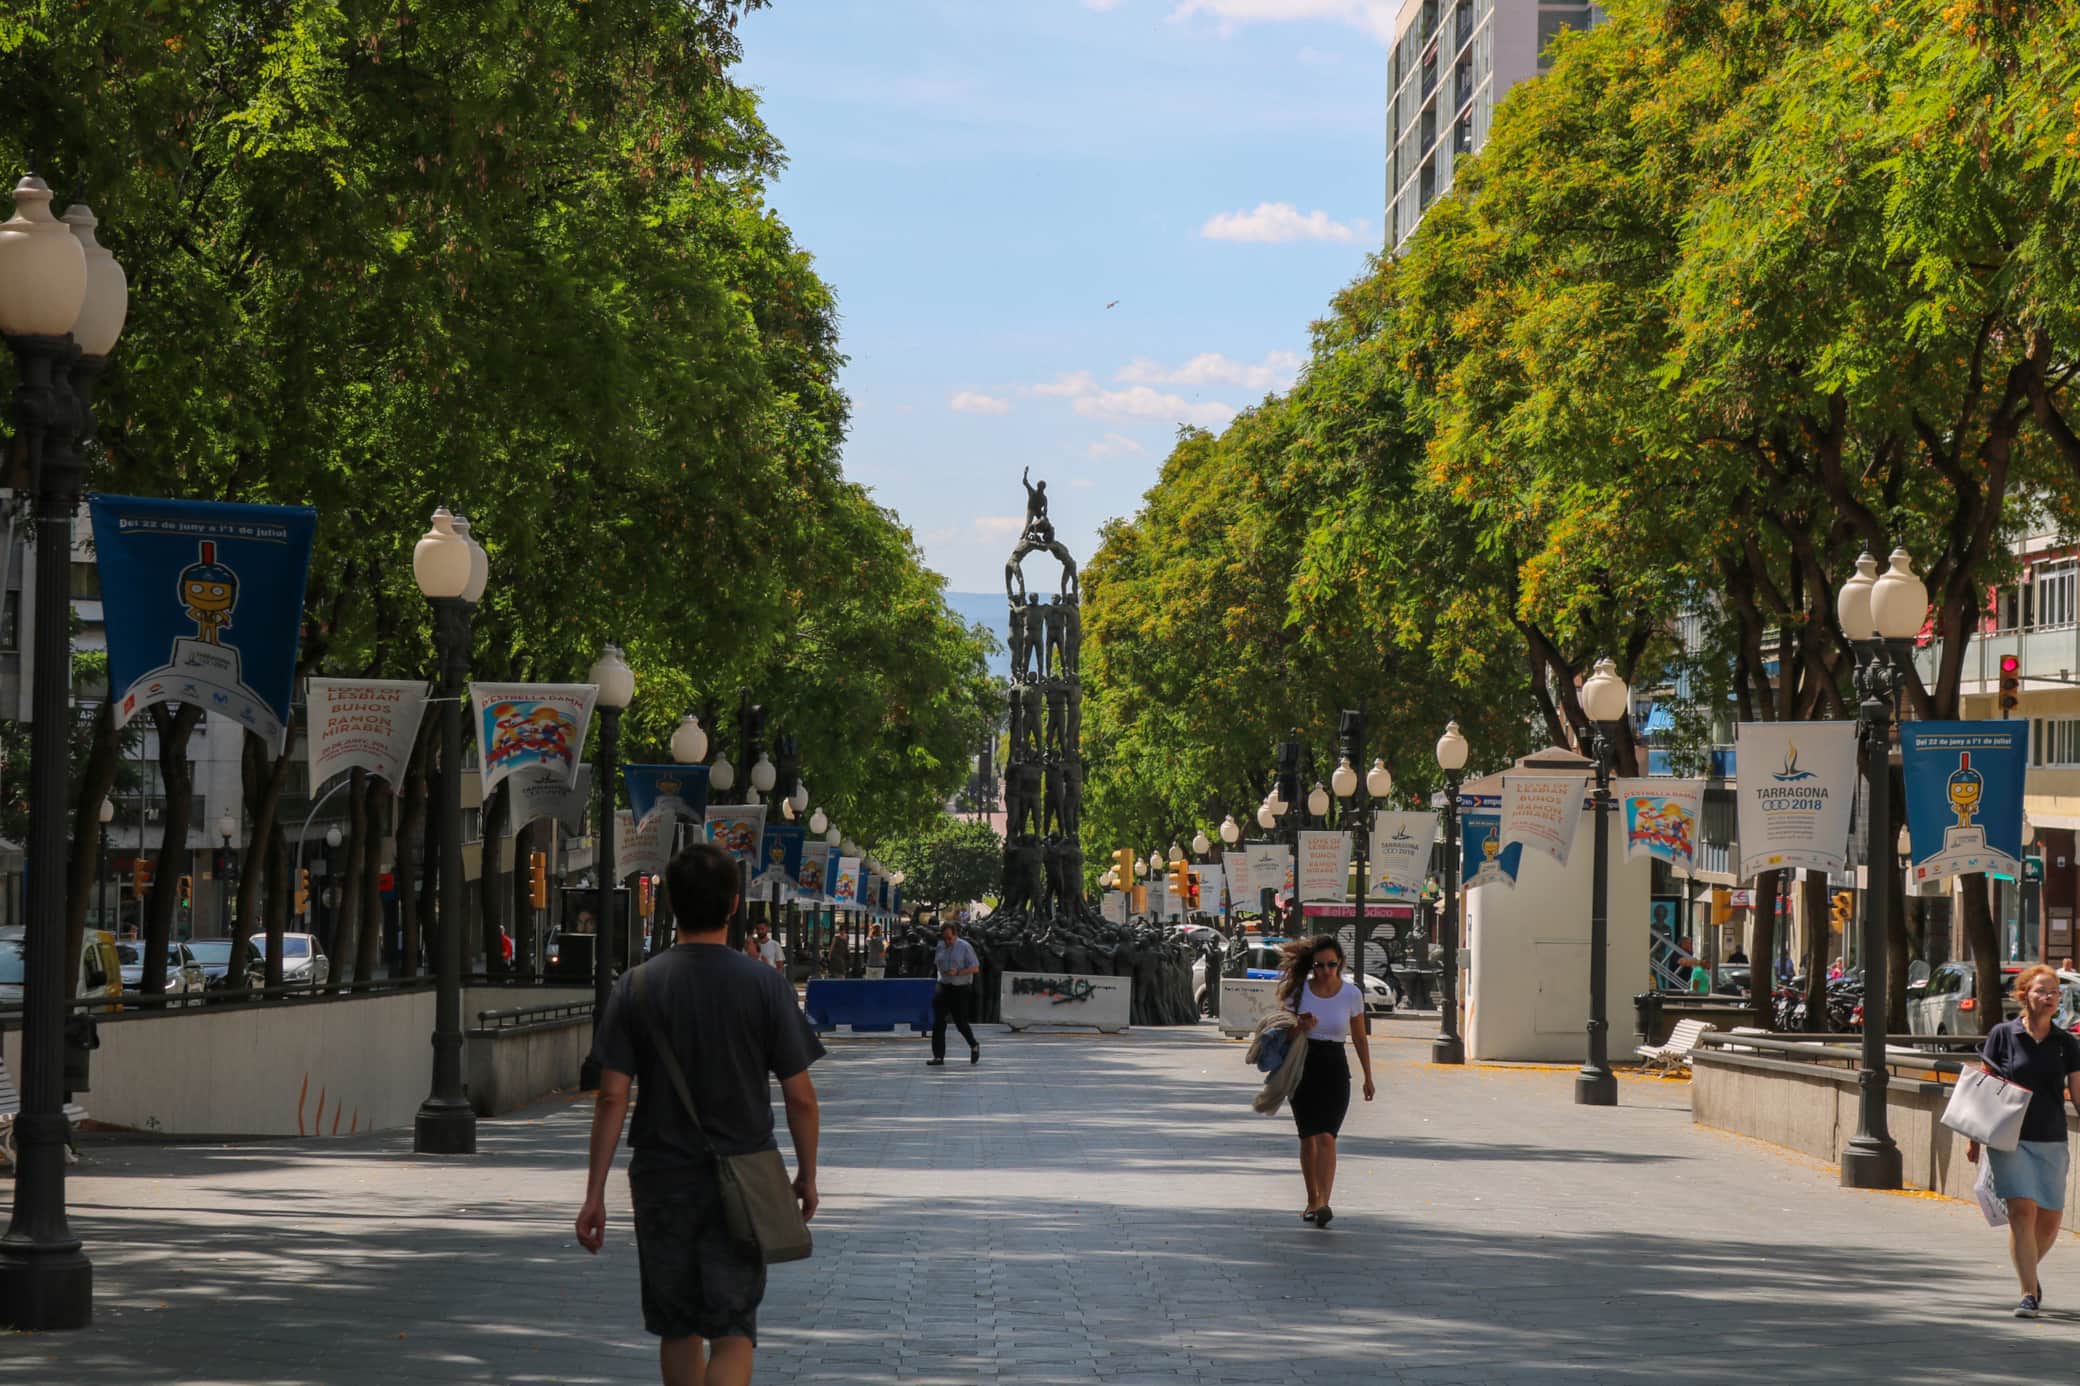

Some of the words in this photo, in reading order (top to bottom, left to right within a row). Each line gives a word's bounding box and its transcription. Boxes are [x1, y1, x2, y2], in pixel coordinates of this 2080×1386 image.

[119, 518, 139, 528] Del
[328, 692, 400, 702] LESBIAN
[331, 703, 392, 714] BUHOS
[328, 715, 392, 727] RAMON
[322, 724, 392, 740] MIRABET
[1916, 738, 1927, 746] Del
[1756, 787, 1829, 799] TARRAGONA
[1792, 799, 1822, 810] 2018
